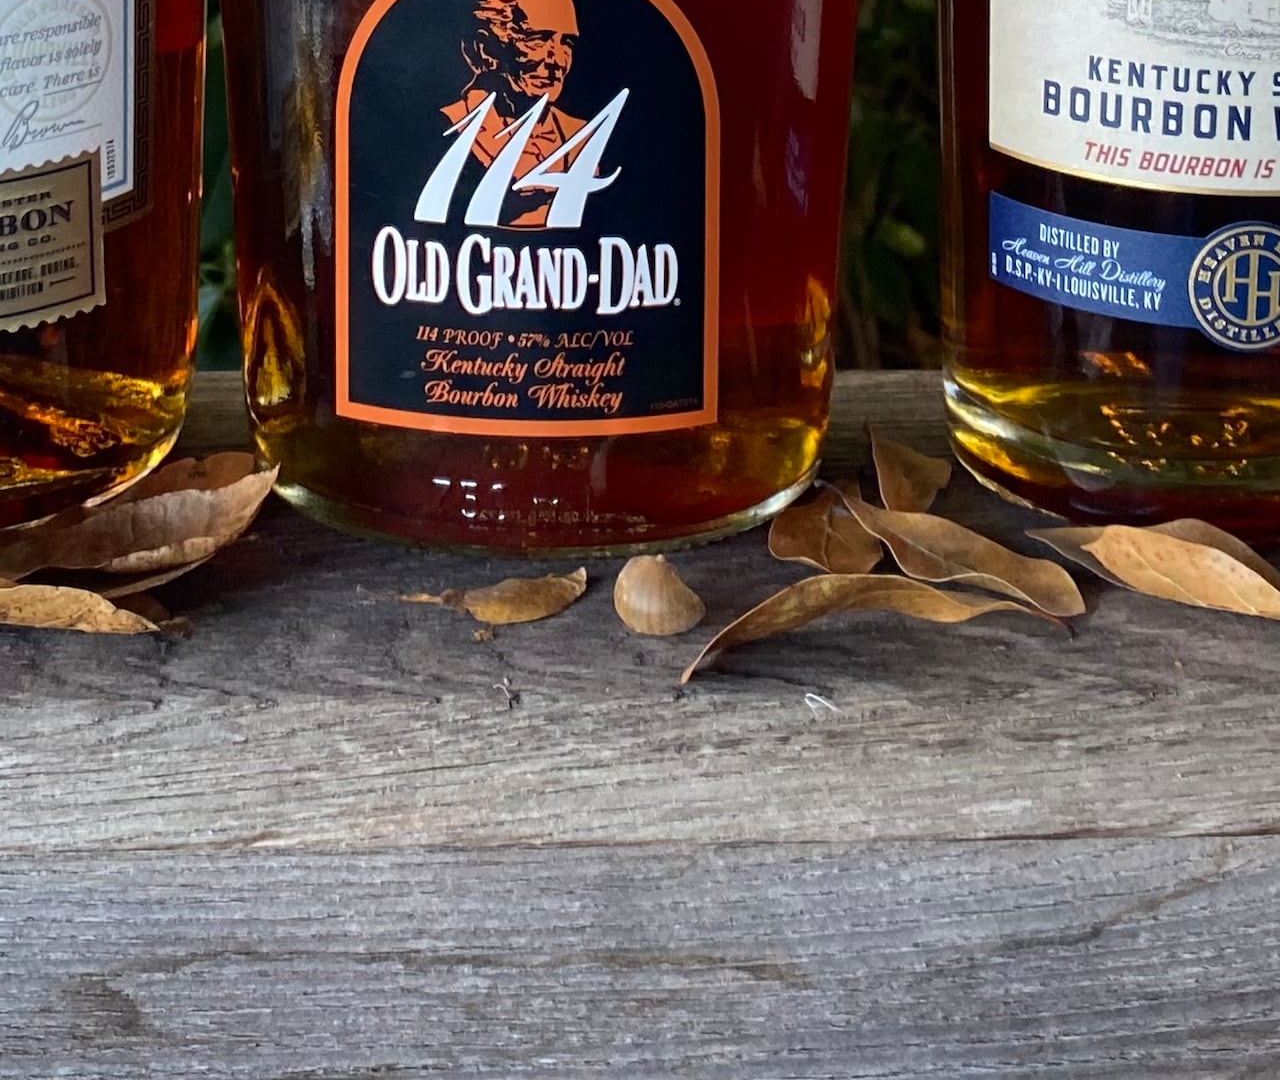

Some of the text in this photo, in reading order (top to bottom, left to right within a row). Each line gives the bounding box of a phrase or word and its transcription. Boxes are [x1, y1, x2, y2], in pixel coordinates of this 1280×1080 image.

[22, 13, 101, 44] responsible
[1088, 54, 1257, 97] KENTUCKY
[1042, 79, 1252, 142] BOURBON
[414, 87, 630, 229] 114
[1084, 141, 1131, 167] THIS
[1138, 150, 1247, 178] BOURBON
[1254, 159, 1275, 178] IS
[27, 234, 57, 247] CO.
[1040, 223, 1120, 258] DISTILLED BY
[1198, 234, 1266, 284] HEAVEN
[372, 225, 451, 305] OLD
[1002, 237, 1051, 265] Heaven
[1054, 255, 1097, 276] Hill
[1099, 259, 1166, 293] Distillery
[1064, 275, 1139, 309] LOUISVILLE,
[1143, 291, 1162, 311] KY
[416, 325, 634, 350] 114 PROOF 57% ALC/VOL
[420, 348, 625, 385] Kentucky Straight
[424, 379, 518, 407] Bourbon
[528, 383, 623, 414] Whiskey
